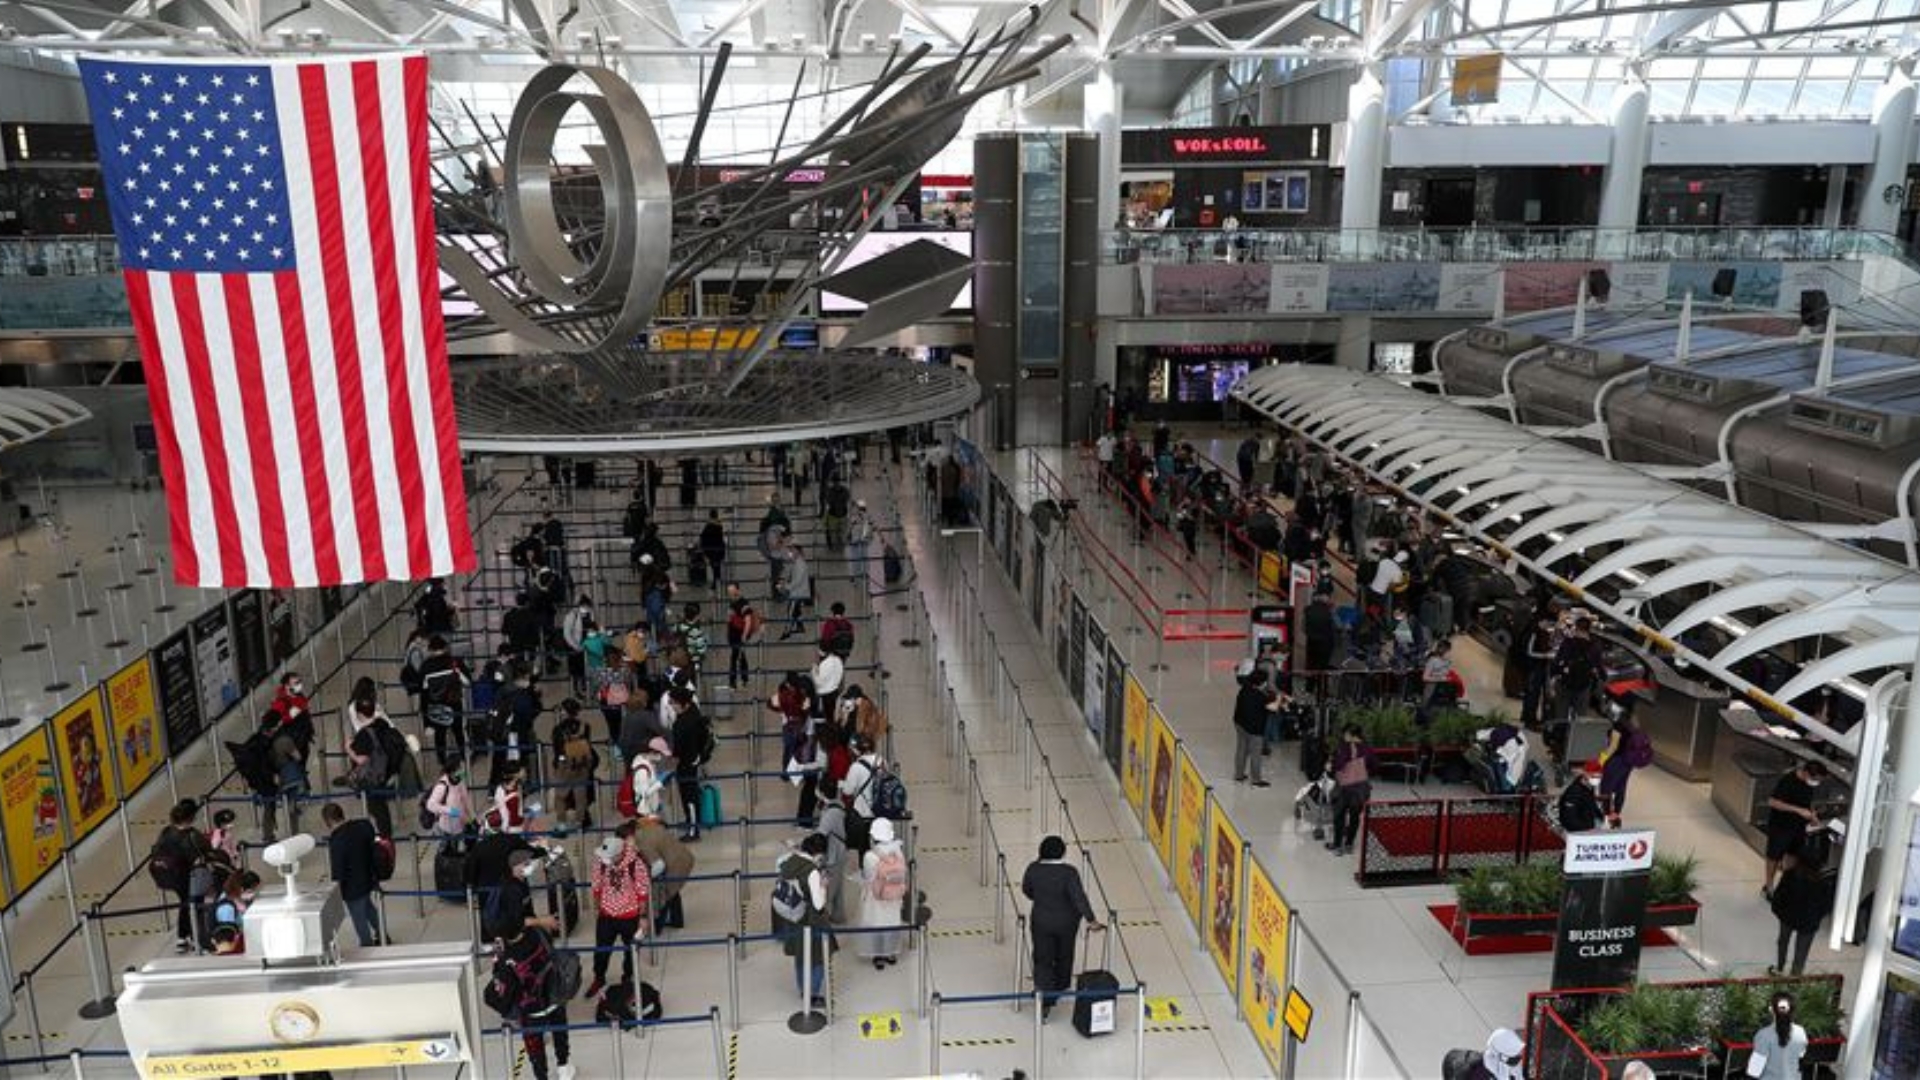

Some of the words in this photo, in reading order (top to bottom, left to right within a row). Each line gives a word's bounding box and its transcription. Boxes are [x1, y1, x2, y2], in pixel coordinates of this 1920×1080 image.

[1577, 843, 1627, 853] TURKISH
[1575, 852, 1626, 862] AIRLINES
[1568, 926, 1636, 942] BUSINESS
[1579, 944, 1623, 957] CLASS
[153, 1064, 177, 1074] All
[183, 1061, 238, 1073] Gates
[243, 1057, 279, 1070] 1-12
